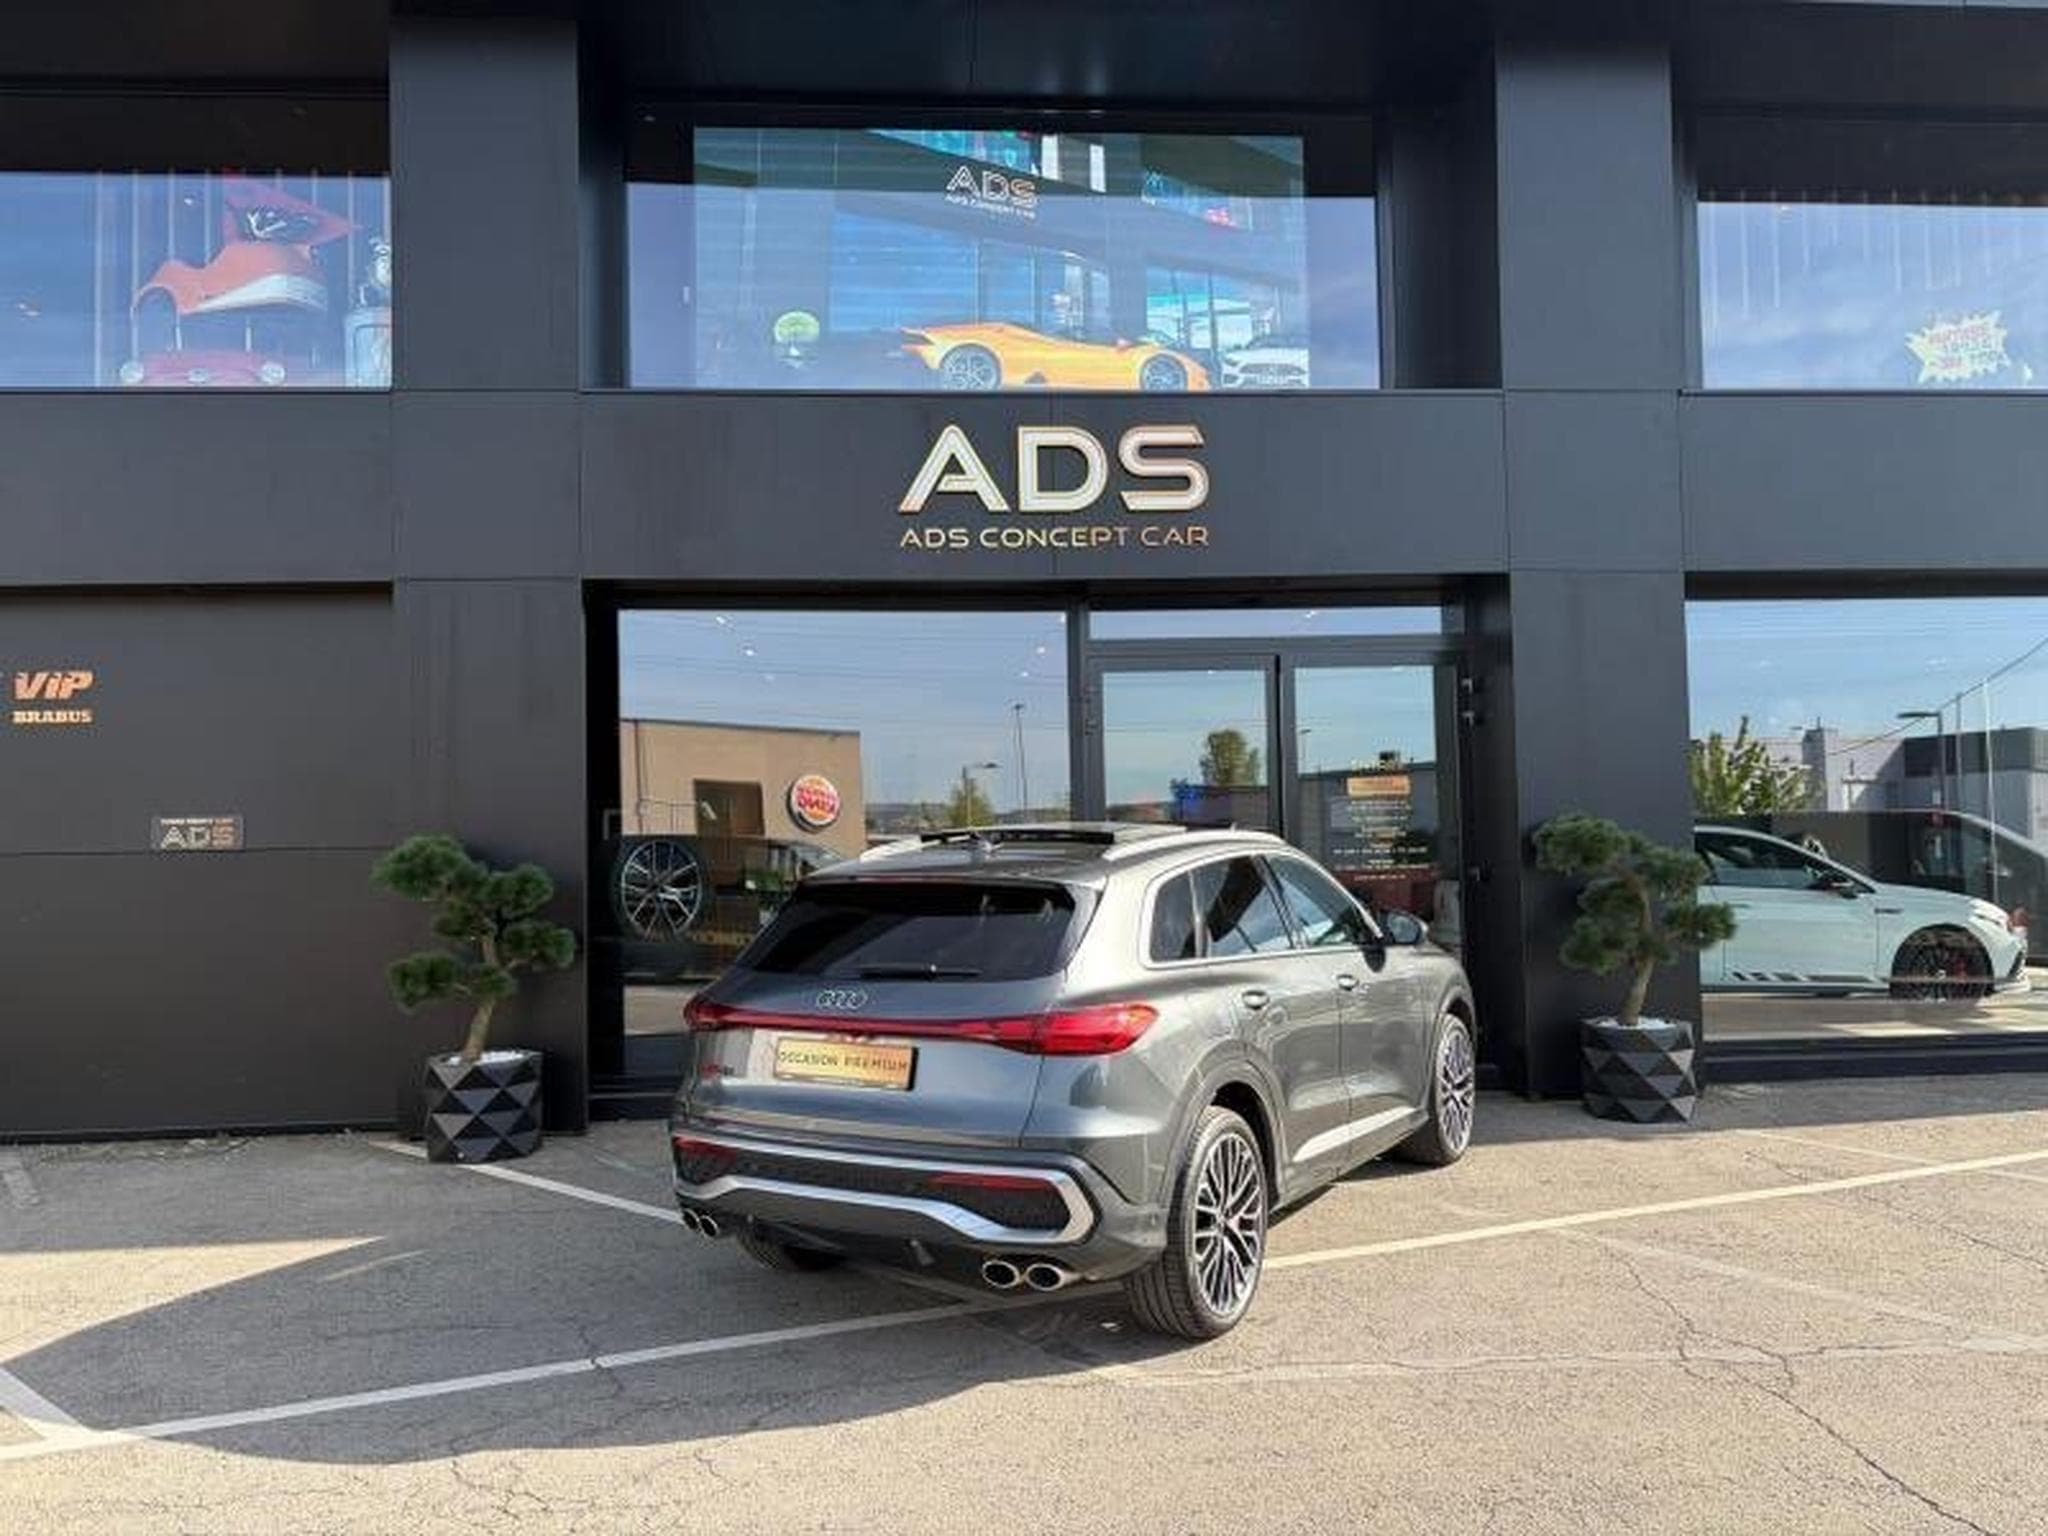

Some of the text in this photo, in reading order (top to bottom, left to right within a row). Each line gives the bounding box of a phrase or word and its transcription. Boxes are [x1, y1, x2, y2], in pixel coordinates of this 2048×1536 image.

[945, 165, 1038, 209] ADS
[898, 424, 1209, 513] ADS
[900, 526, 1209, 548] ADS CONCEPT CAR
[13, 709, 93, 724] BRABUS
[160, 825, 236, 850] ADS
[778, 1051, 909, 1071] OCCASION PREMIUM
